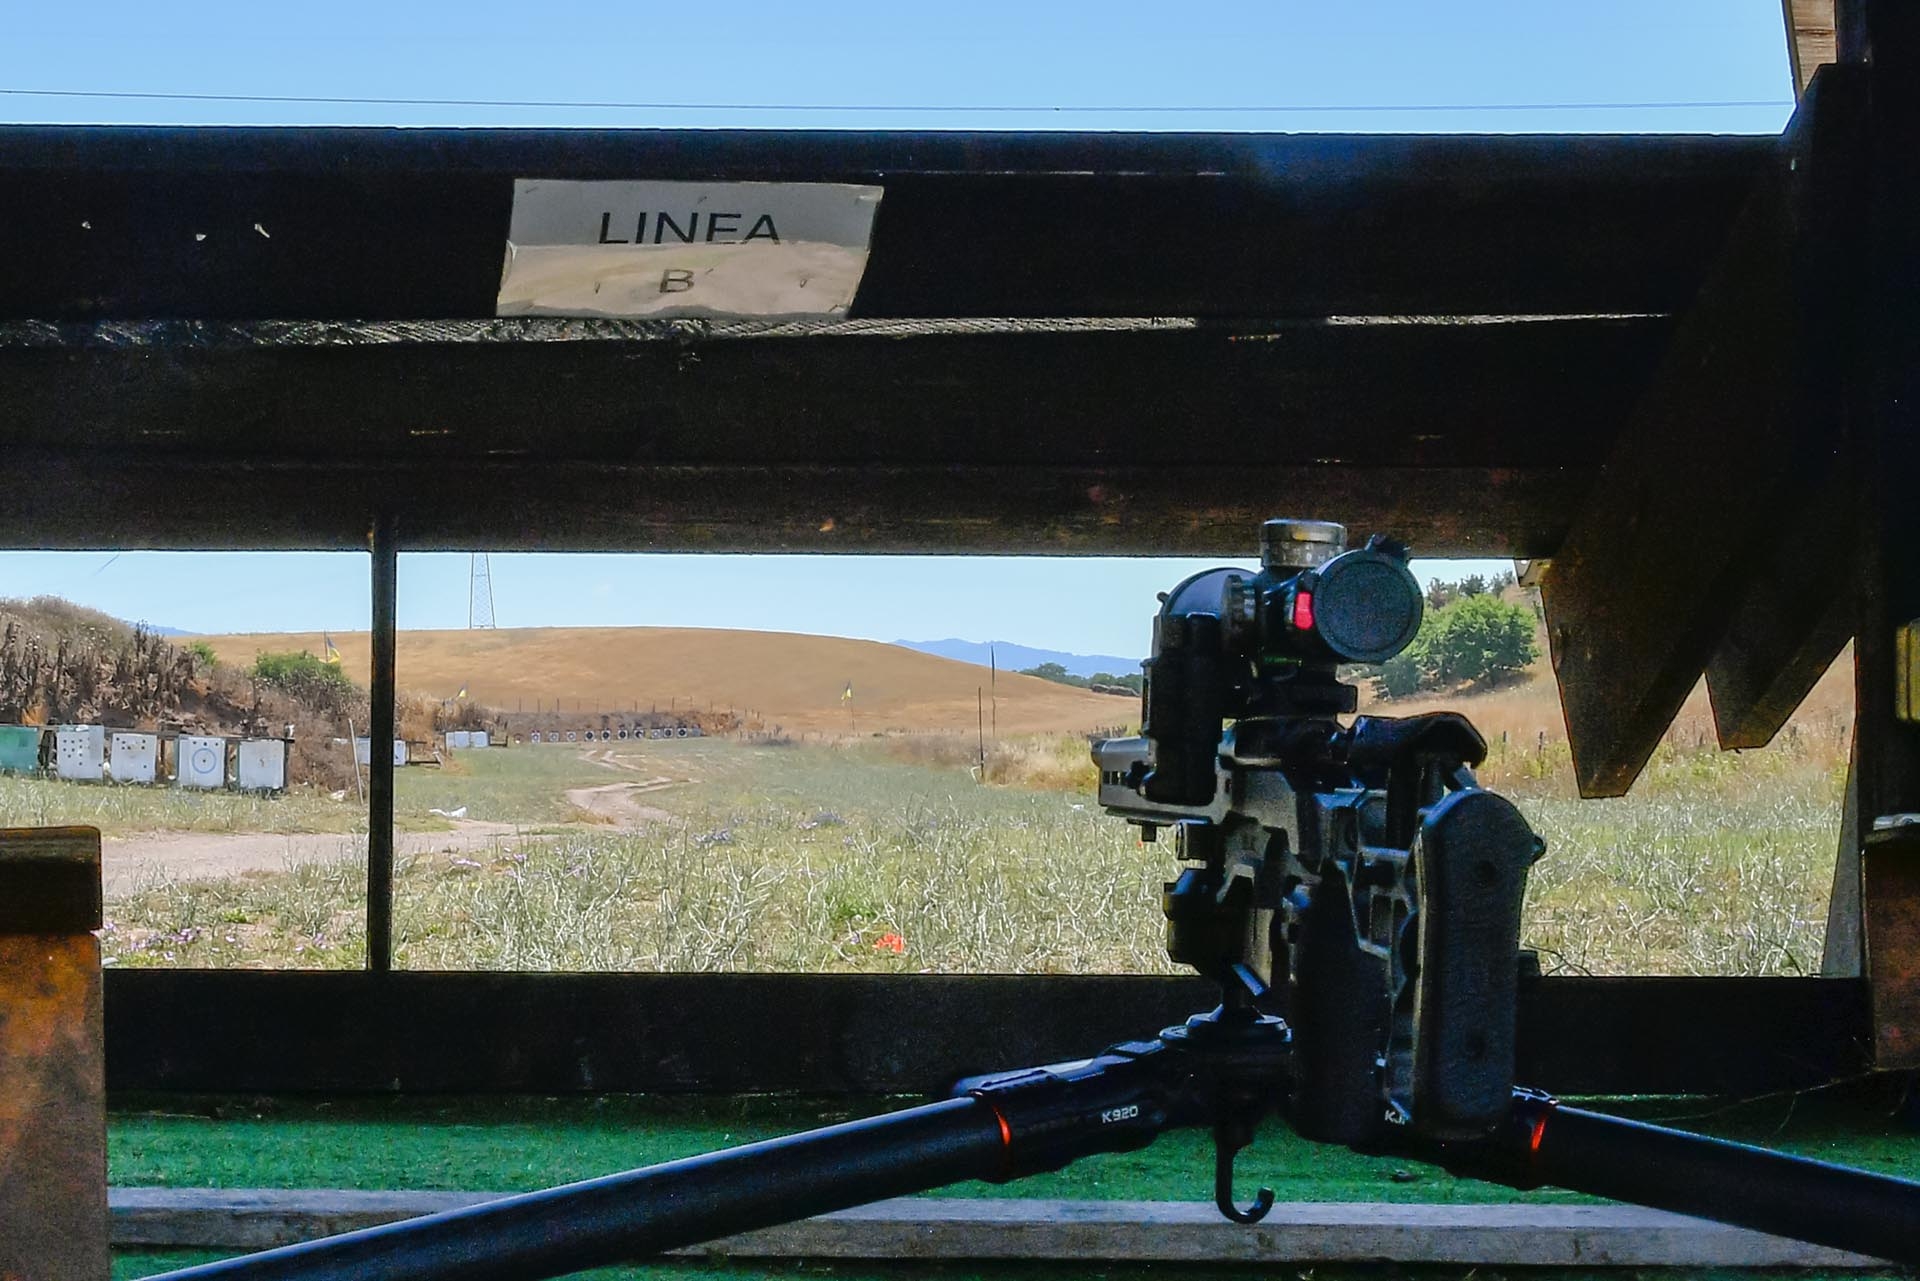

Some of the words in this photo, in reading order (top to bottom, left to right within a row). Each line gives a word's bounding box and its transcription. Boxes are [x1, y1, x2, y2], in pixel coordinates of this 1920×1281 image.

[598, 211, 781, 245] LINEA
[659, 269, 695, 293] B
[1102, 1105, 1139, 1124] K920
